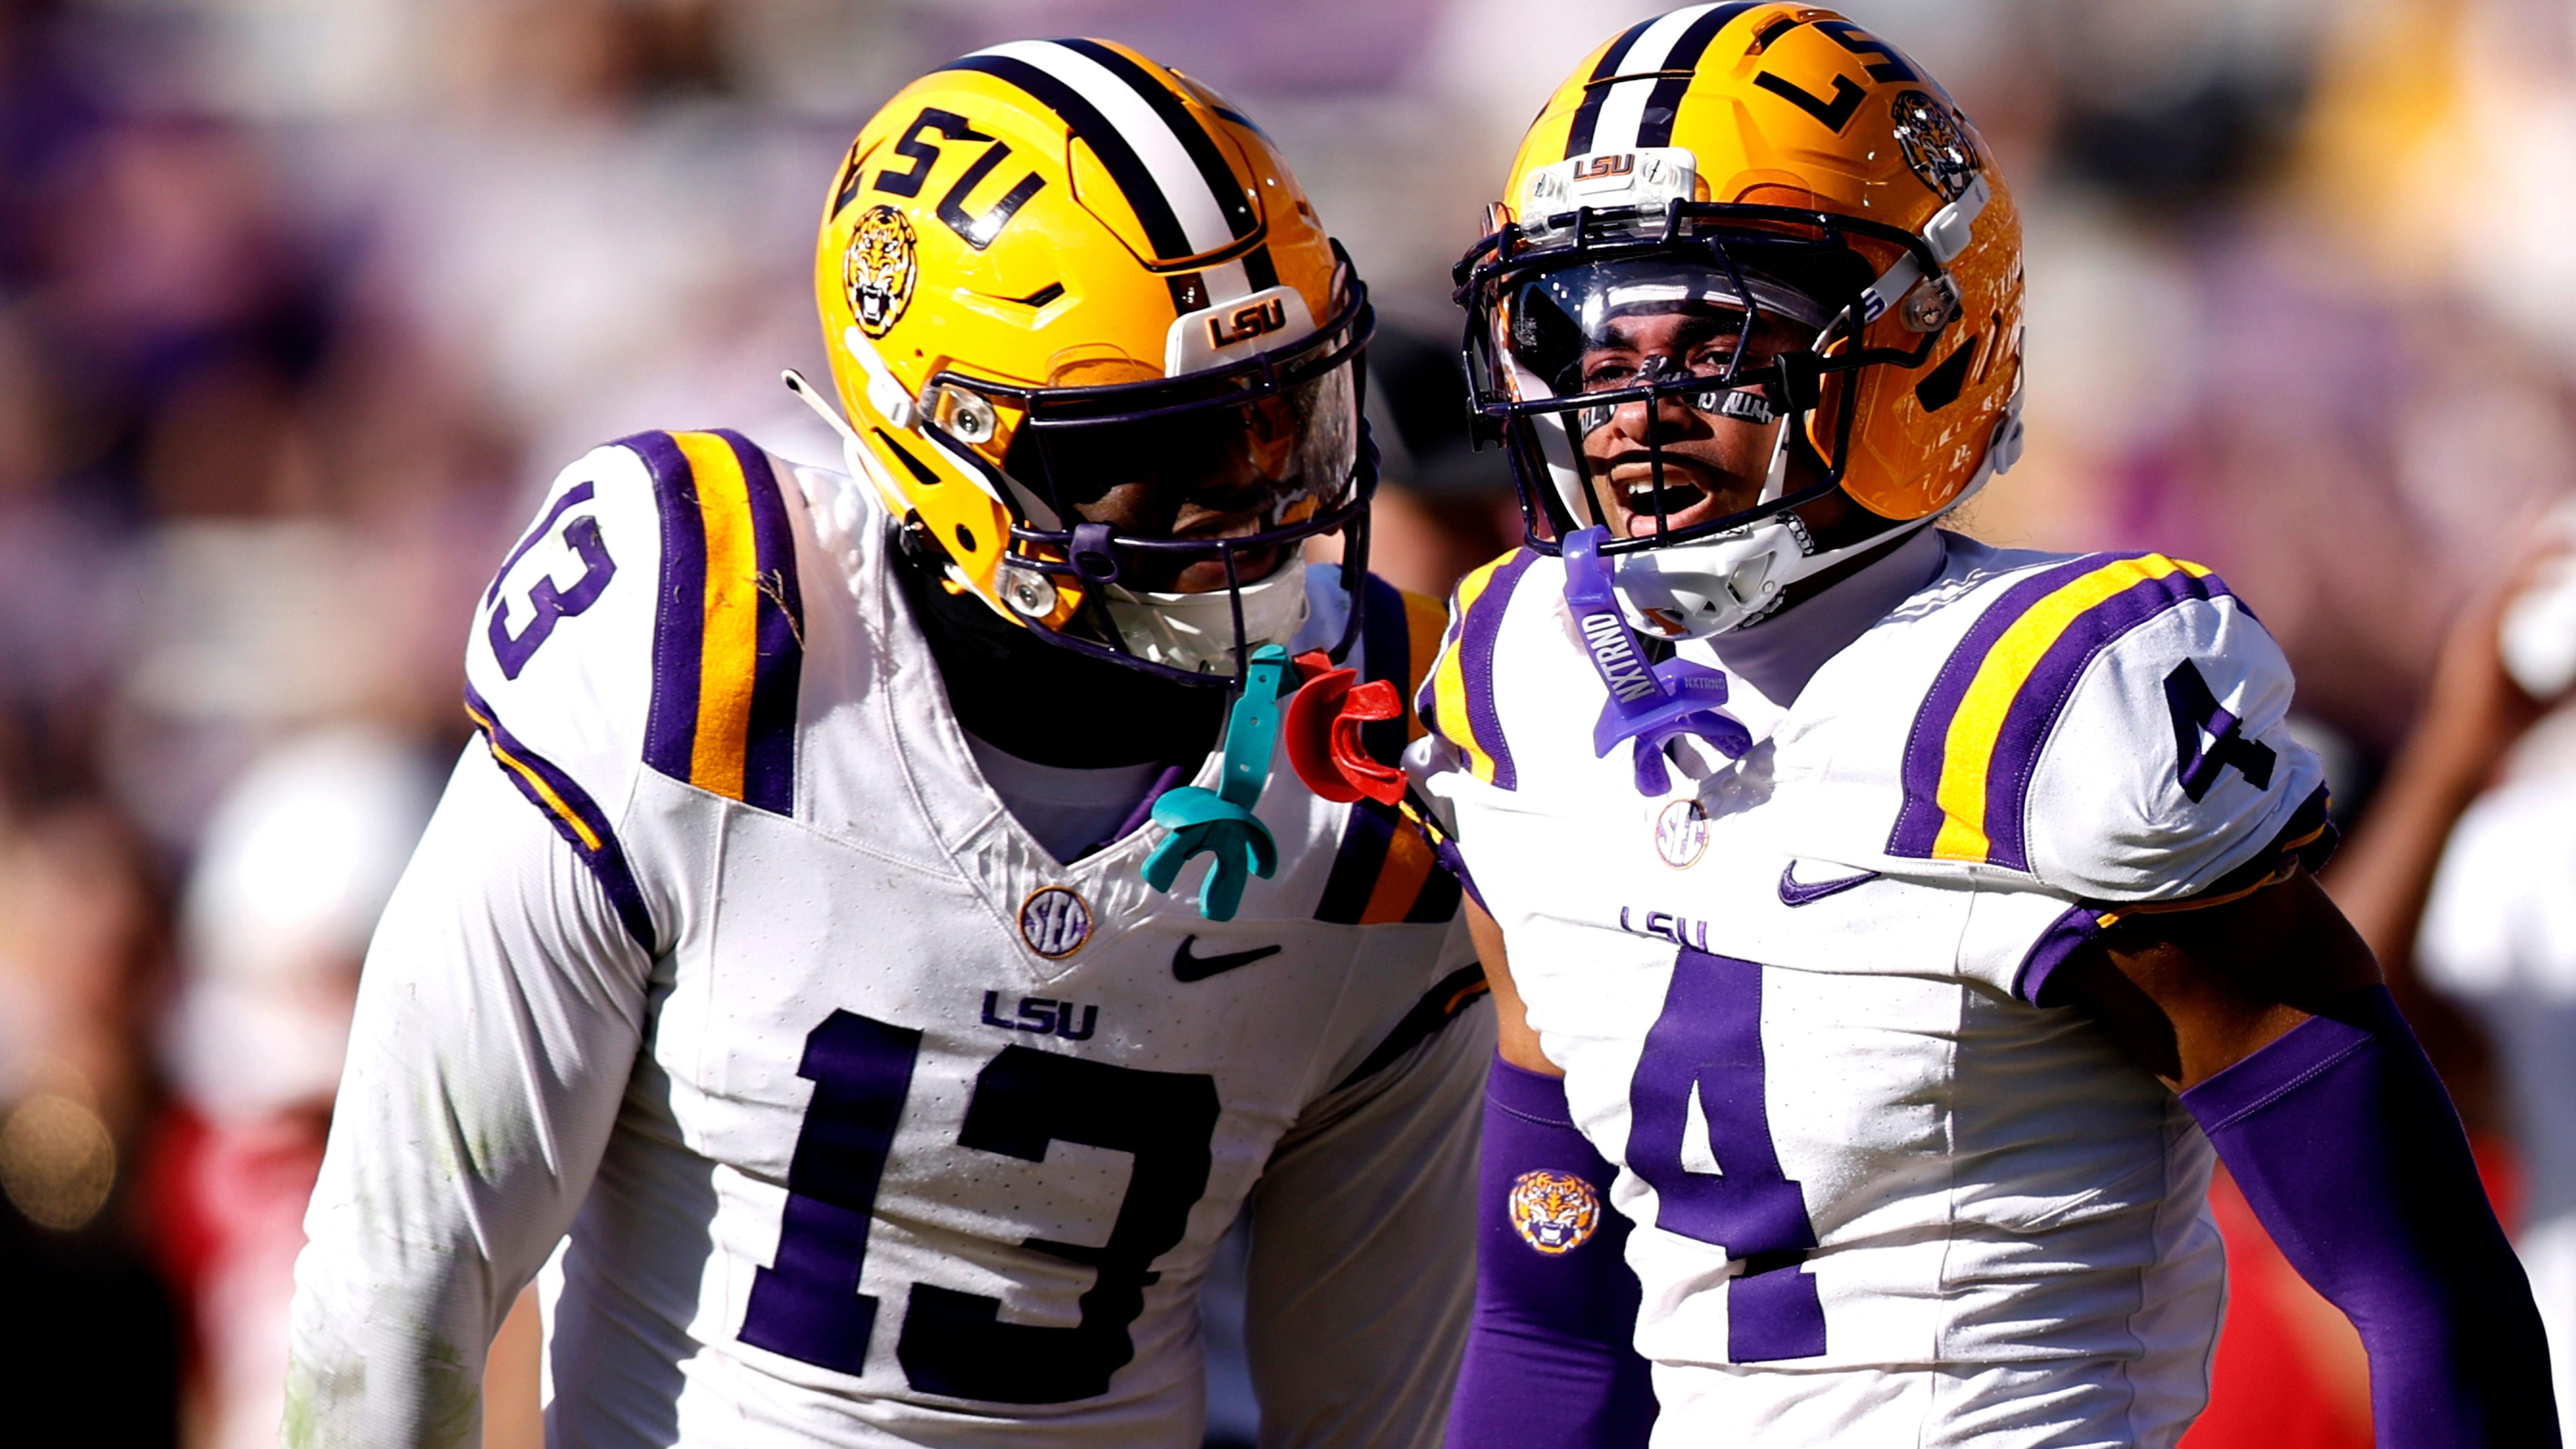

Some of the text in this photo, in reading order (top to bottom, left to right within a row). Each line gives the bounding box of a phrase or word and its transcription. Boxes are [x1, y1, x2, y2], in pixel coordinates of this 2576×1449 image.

[831, 107, 1047, 251] LSU
[1573, 154, 1636, 182] LSU
[1205, 297, 1286, 350] LSU
[485, 480, 617, 681] 13
[1582, 613, 1656, 704] NXTRND
[1685, 676, 1726, 690] NXTRND
[2162, 657, 2277, 804] 4
[1024, 890, 1089, 953] SEC
[982, 991, 1098, 1041] LSU
[1625, 945, 1826, 1363] 4
[736, 1007, 1222, 1405] 13
